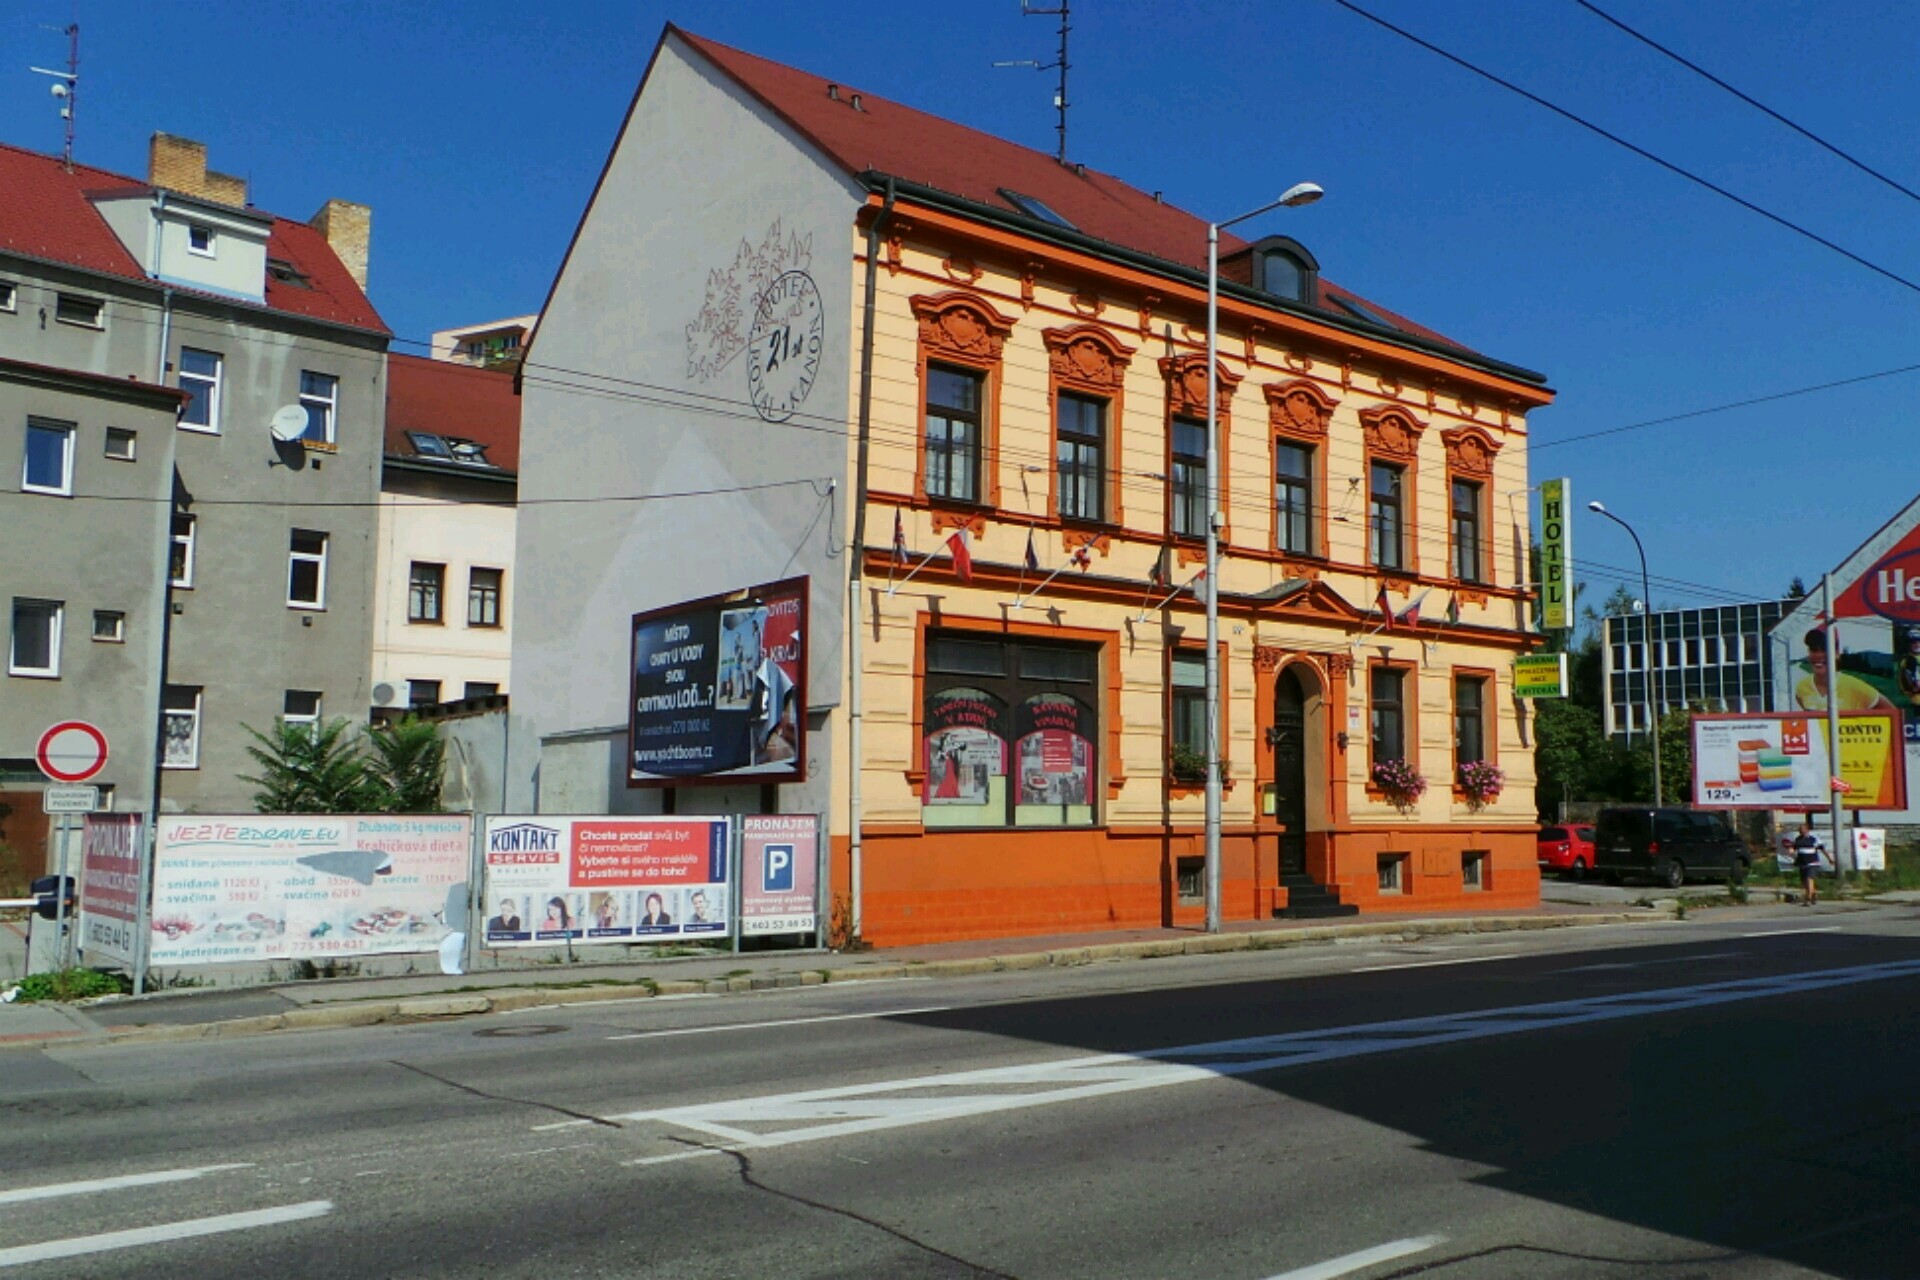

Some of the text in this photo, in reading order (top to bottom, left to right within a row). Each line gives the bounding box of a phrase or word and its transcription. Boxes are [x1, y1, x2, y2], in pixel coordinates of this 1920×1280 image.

[749, 348, 776, 417] ROYAL
[1545, 501, 1562, 603] HOTEL
[664, 624, 690, 643] MÍSTO
[671, 647, 679, 664] U
[679, 644, 704, 663] VODY
[665, 669, 686, 684] SVOU
[1838, 724, 1882, 735] CONTO
[491, 828, 559, 852] KONTAKT
[579, 830, 618, 841] Chcete
[619, 830, 653, 843] prodat
[674, 829, 691, 842] byt
[430, 839, 463, 852] dieta
[493, 853, 556, 865] SERVIS
[578, 854, 619, 868] Vyberte
[620, 854, 631, 865] si
[769, 850, 789, 880] P
[578, 869, 586, 879] a
[631, 868, 644, 878] se
[645, 867, 660, 877] do
[167, 878, 220, 889] snídaně
[284, 876, 316, 887] oběd
[167, 893, 217, 904] svačina
[284, 888, 329, 900] svačina
